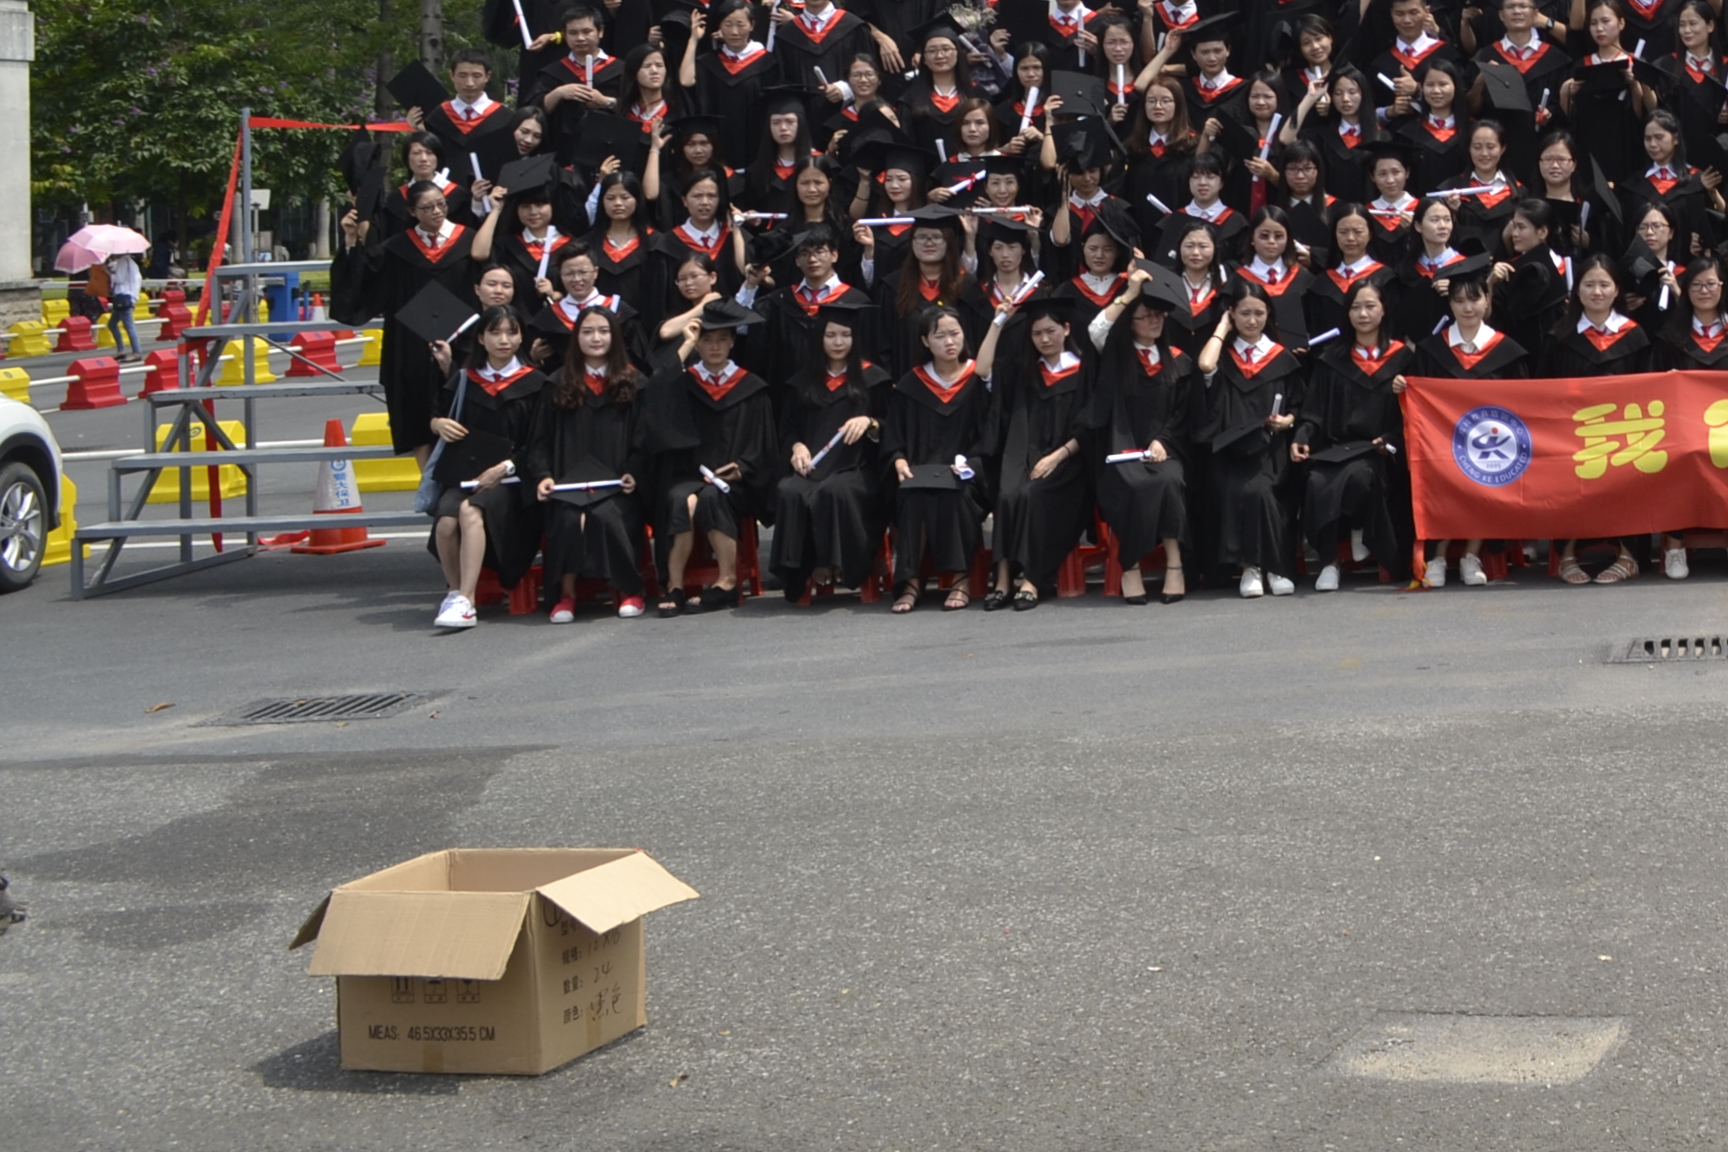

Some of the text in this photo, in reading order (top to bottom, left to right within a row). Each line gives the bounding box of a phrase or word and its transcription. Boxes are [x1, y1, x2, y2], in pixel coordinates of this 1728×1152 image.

[1459, 455, 1481, 479] CHENG
[1481, 475, 1492, 484] KE
[479, 1026, 496, 1041] CM
